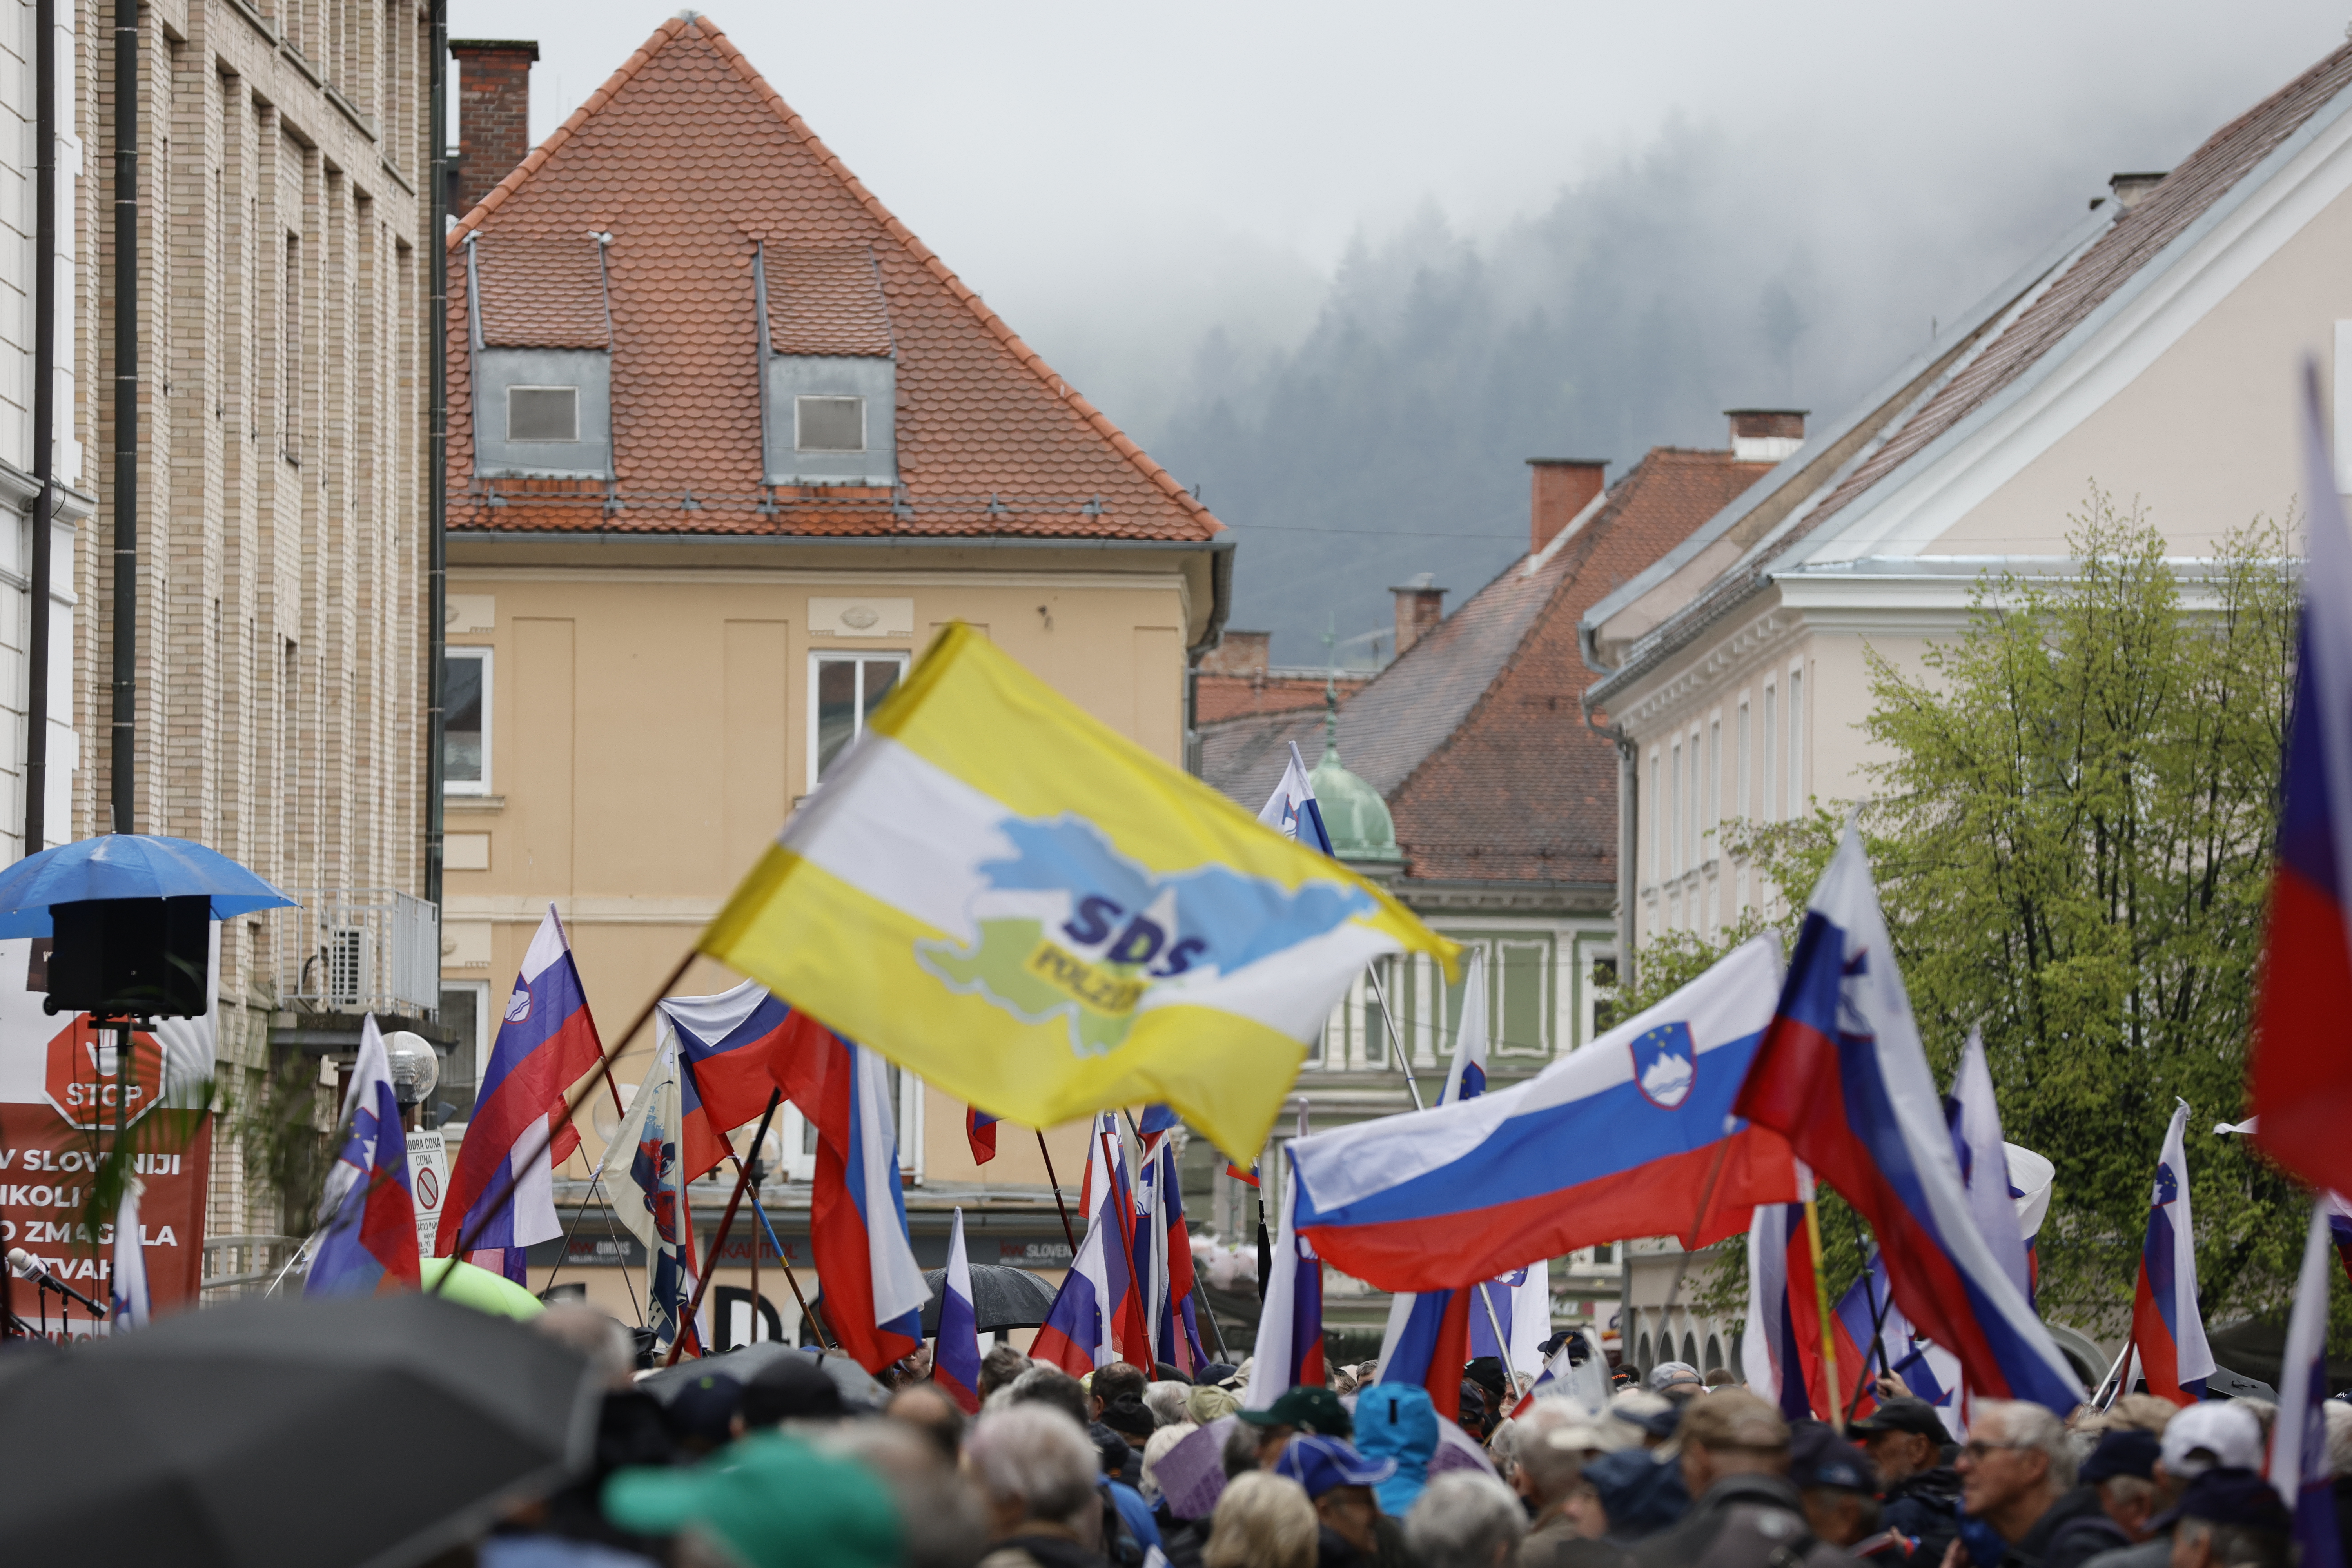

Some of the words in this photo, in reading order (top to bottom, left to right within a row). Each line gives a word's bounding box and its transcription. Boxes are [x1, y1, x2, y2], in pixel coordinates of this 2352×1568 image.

[1062, 894, 1207, 978] SDS
[66, 1082, 142, 1107] STOP
[425, 1137, 441, 1149] CONA
[23, 1149, 181, 1175] SLOVNIJI
[416, 1154, 432, 1166] CONA
[24, 1221, 178, 1247] ZMAGLA
[417, 1221, 428, 1231] AČILO
[722, 1242, 798, 1259] KAITOL
[1026, 1243, 1081, 1258] SLOVEN
